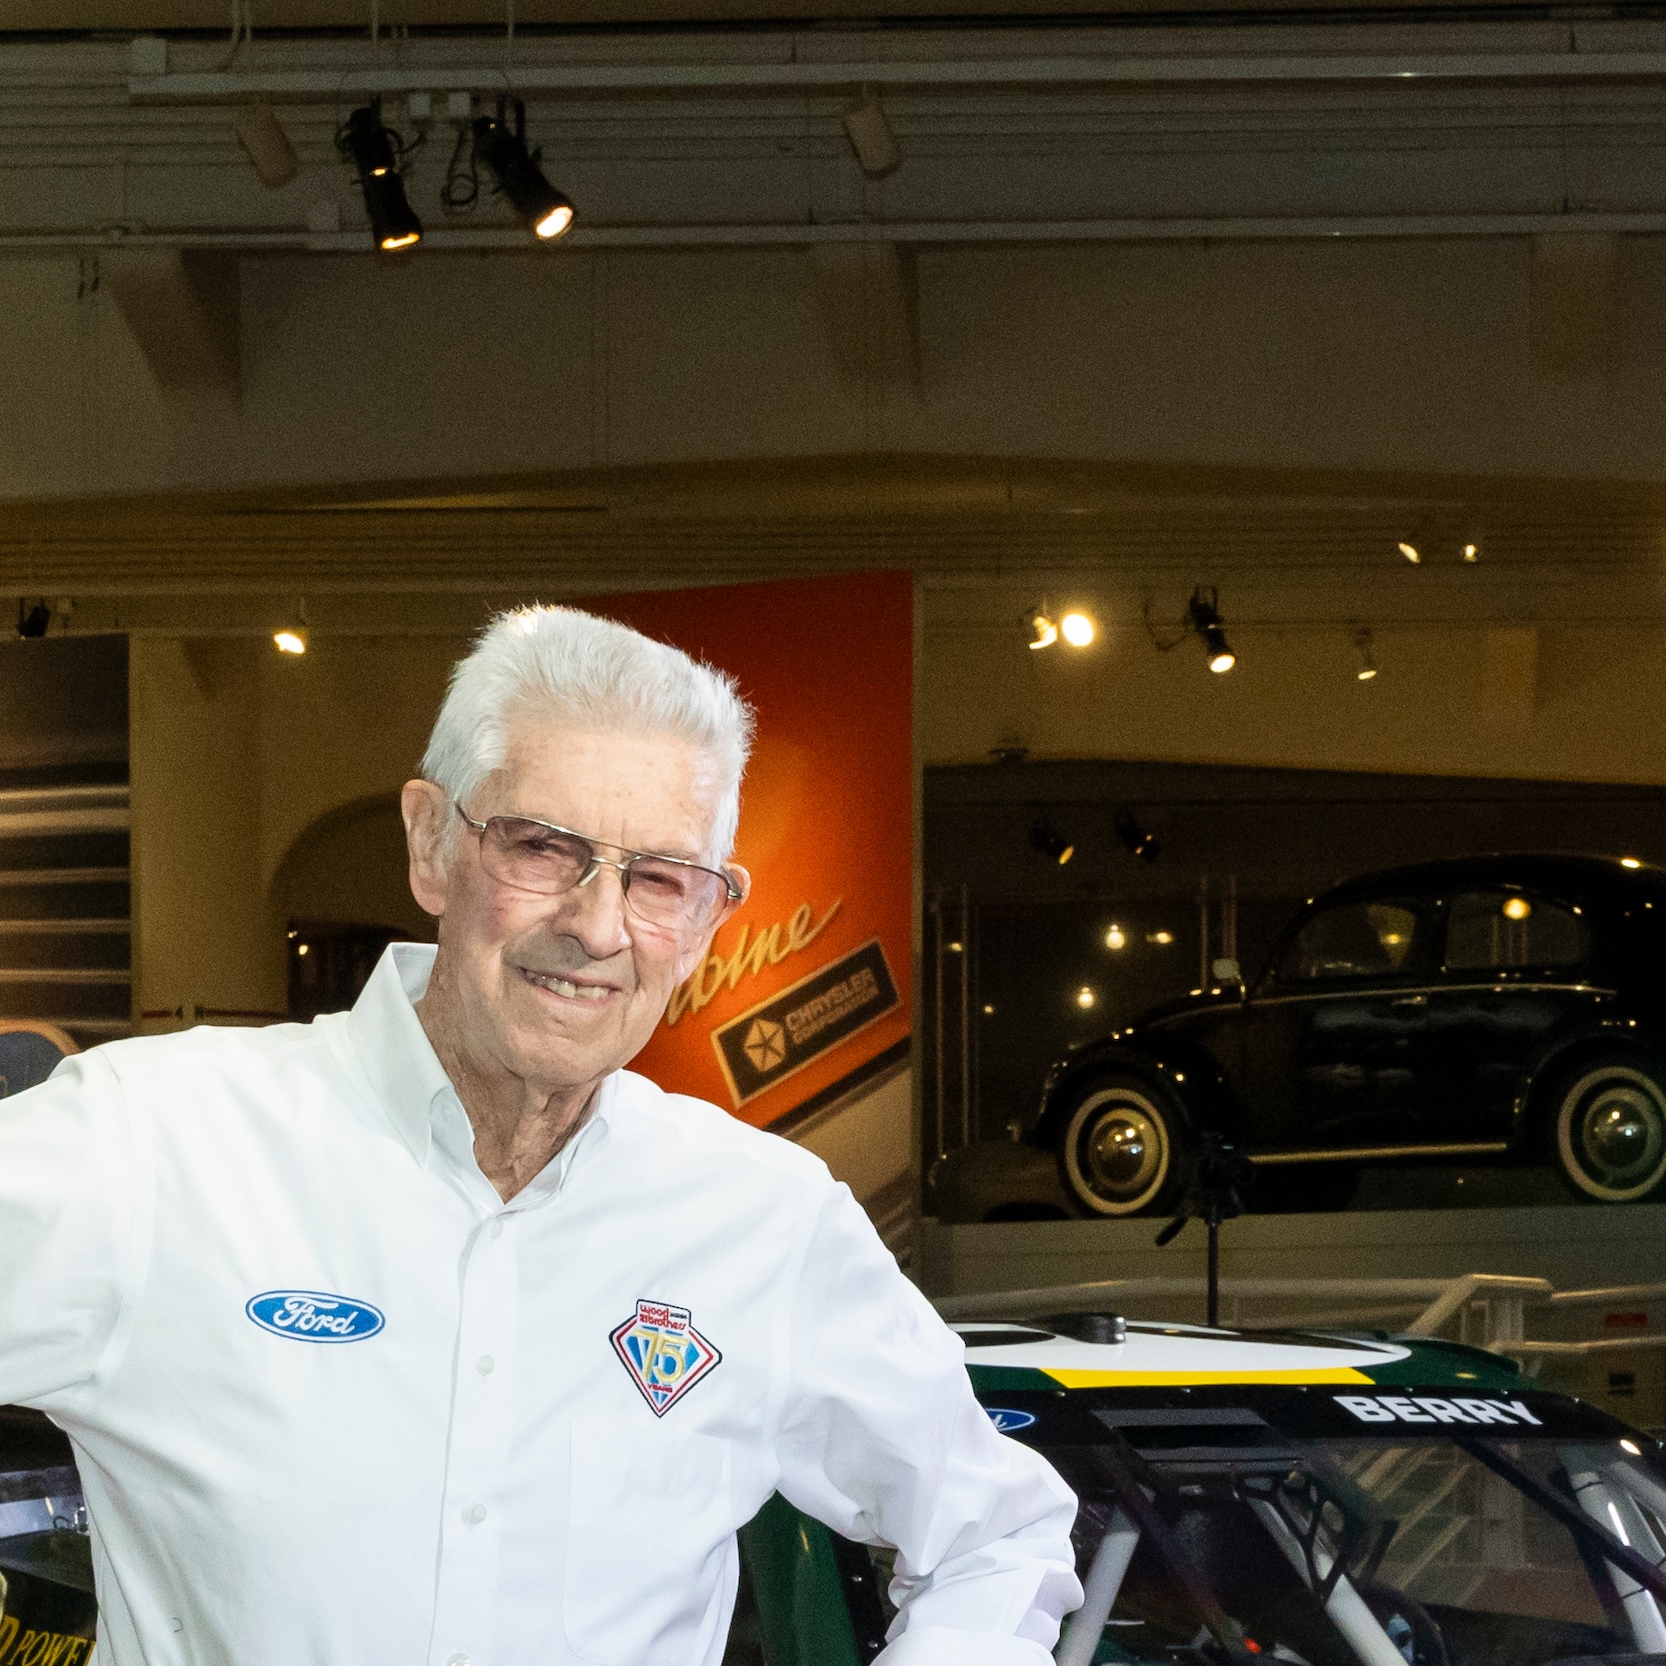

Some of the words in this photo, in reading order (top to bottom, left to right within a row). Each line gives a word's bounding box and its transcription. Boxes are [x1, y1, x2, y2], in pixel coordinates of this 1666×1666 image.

[665, 898, 841, 1026] bine
[785, 966, 879, 1032] CHRYSLER
[273, 1296, 359, 1335] Ford
[633, 1329, 689, 1384] 75
[1332, 1396, 1544, 1426] BERRY
